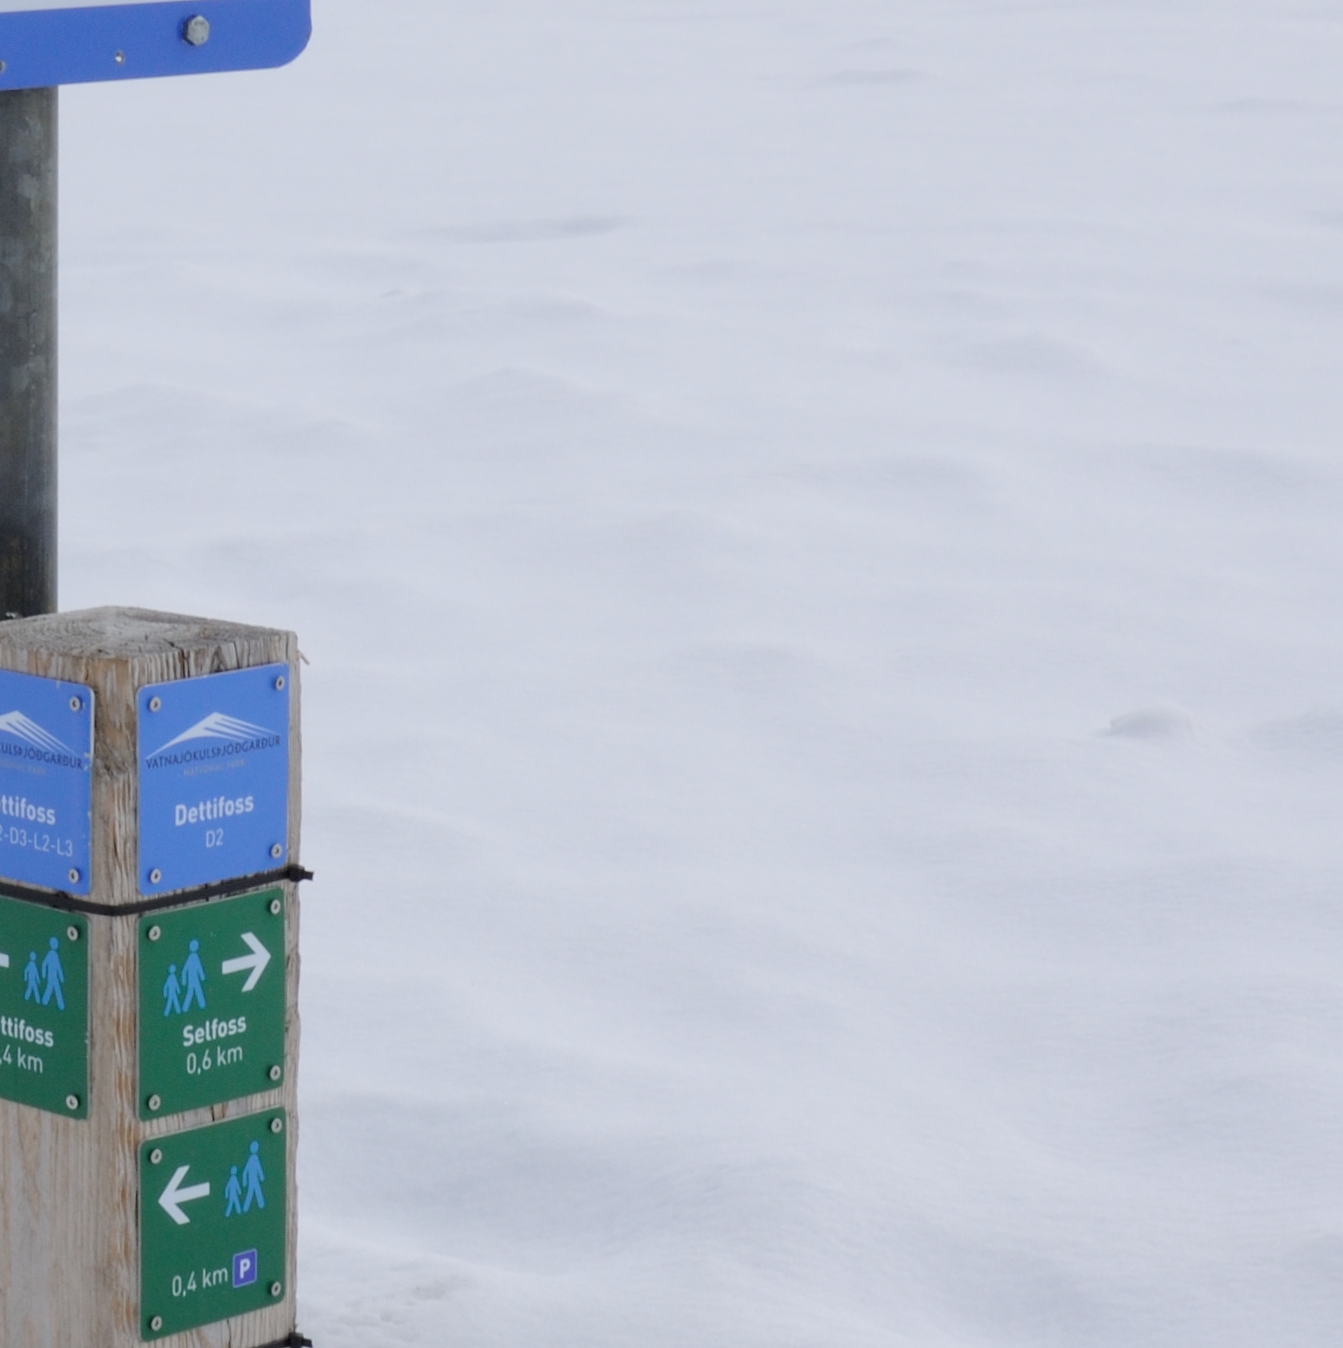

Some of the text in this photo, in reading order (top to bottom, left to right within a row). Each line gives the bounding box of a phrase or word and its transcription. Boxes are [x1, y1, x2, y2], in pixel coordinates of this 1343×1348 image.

[146, 735, 281, 770] VATNAJÖKULSÞJÓÐGARÐUR
[175, 794, 254, 826] Dettifoss
[206, 828, 224, 848] D2
[182, 1016, 247, 1047] Selfoss
[17, 1051, 43, 1073] km
[186, 1046, 243, 1075] 0,6 km
[171, 1257, 251, 1298] 0,4 km P
